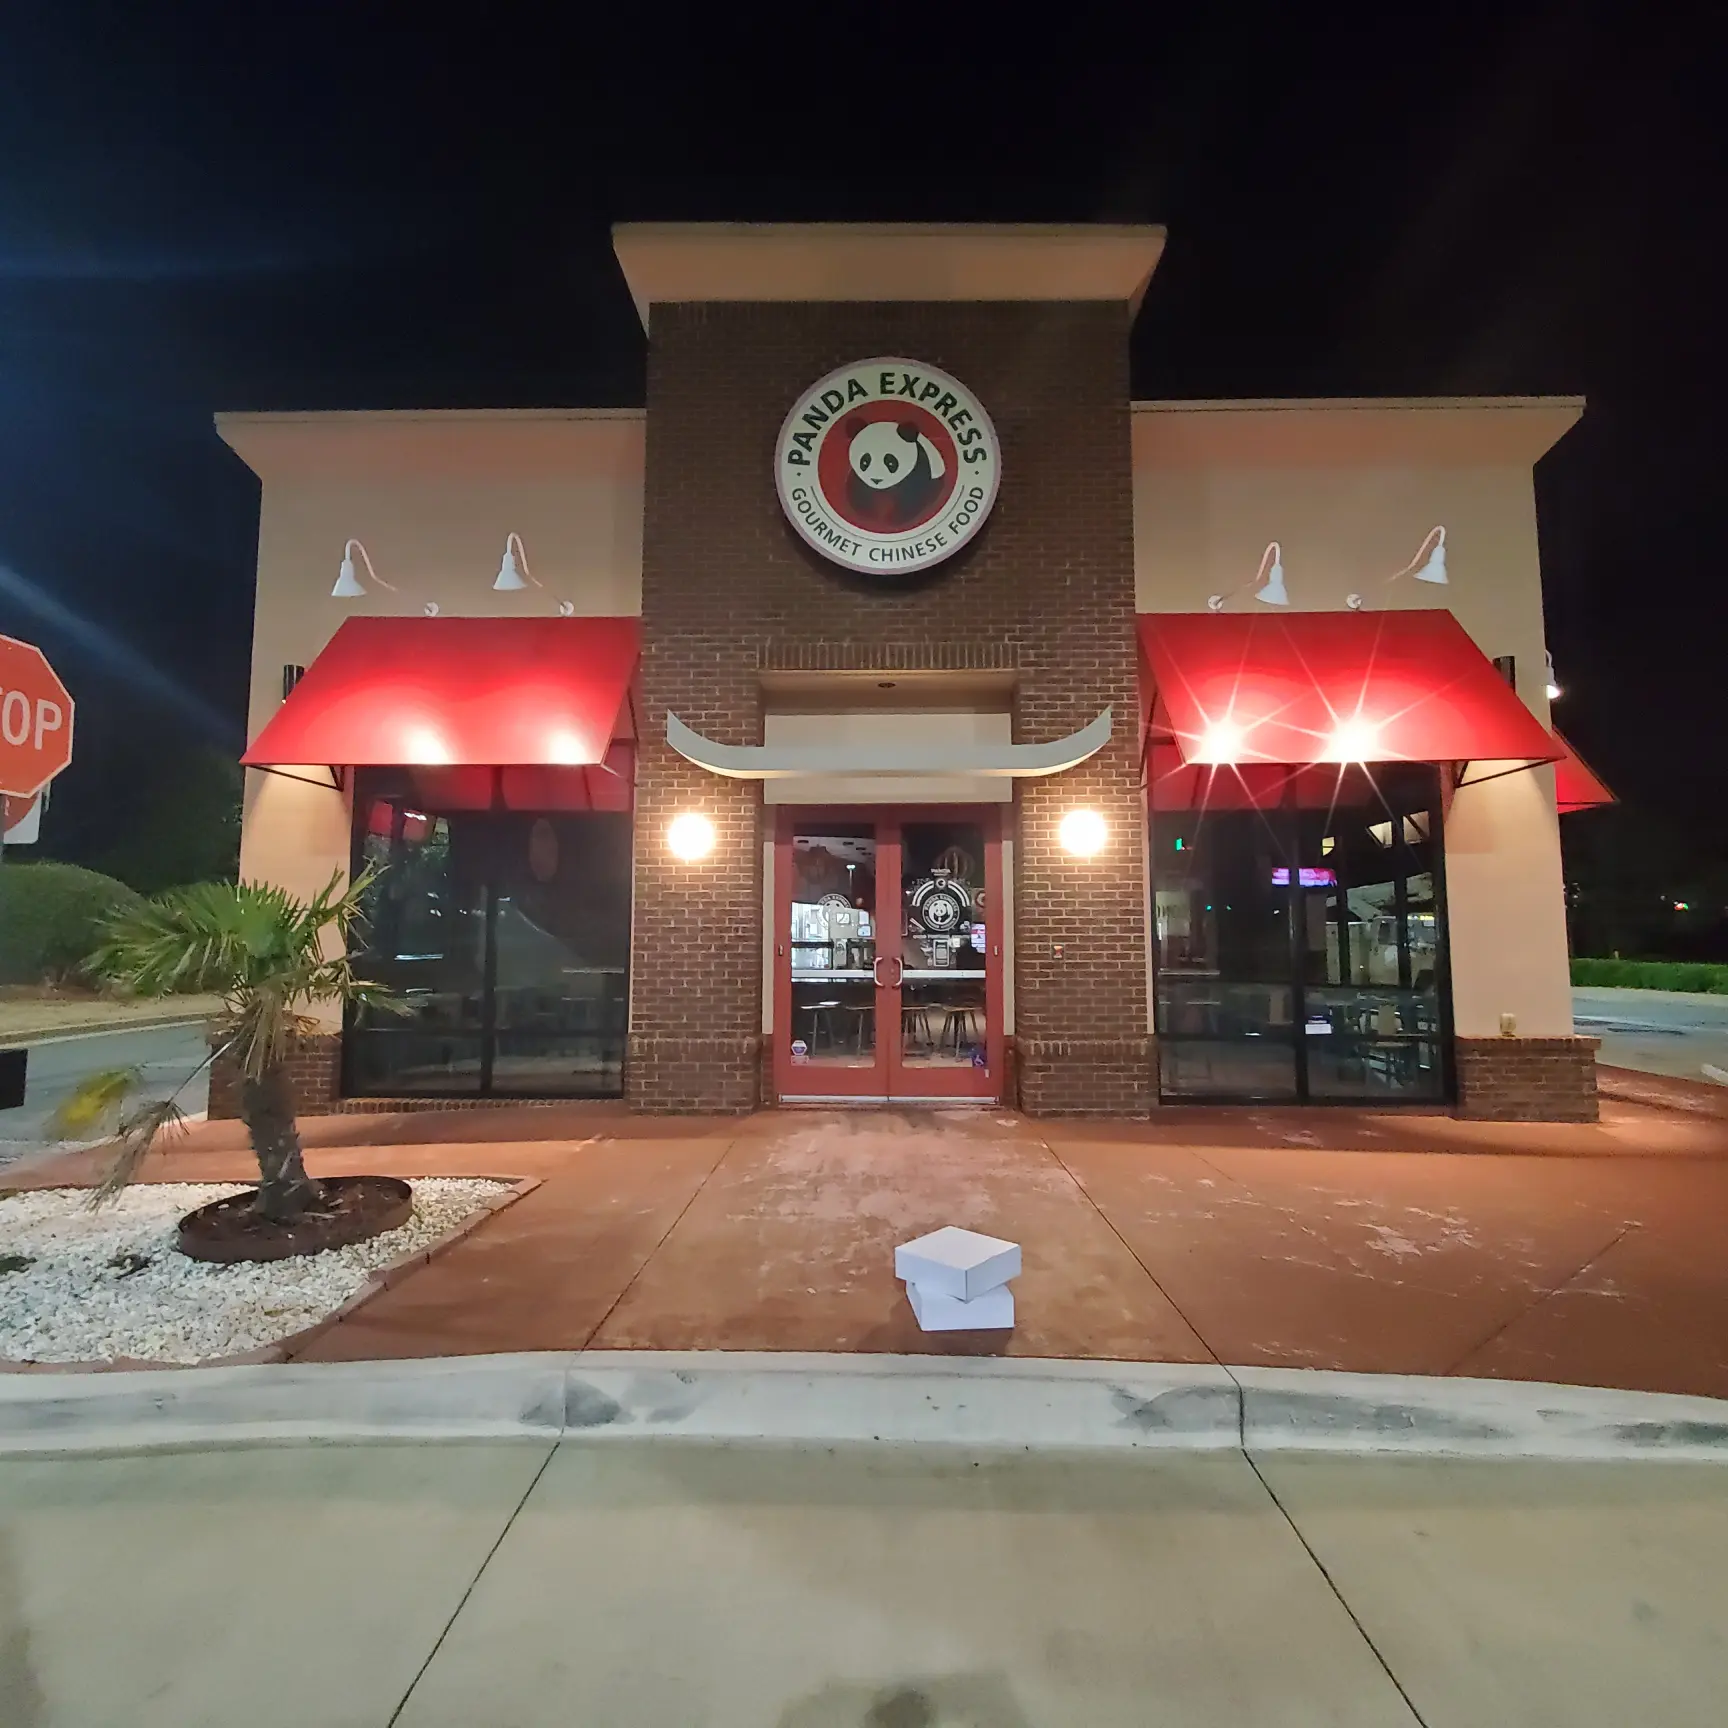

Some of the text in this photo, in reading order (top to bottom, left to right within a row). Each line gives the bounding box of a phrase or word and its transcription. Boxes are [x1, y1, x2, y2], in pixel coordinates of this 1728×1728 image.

[787, 372, 987, 466] PANDA EXPRESS
[792, 486, 984, 562] GOURMET CHINESE FOOD
[0, 687, 62, 750] OP
